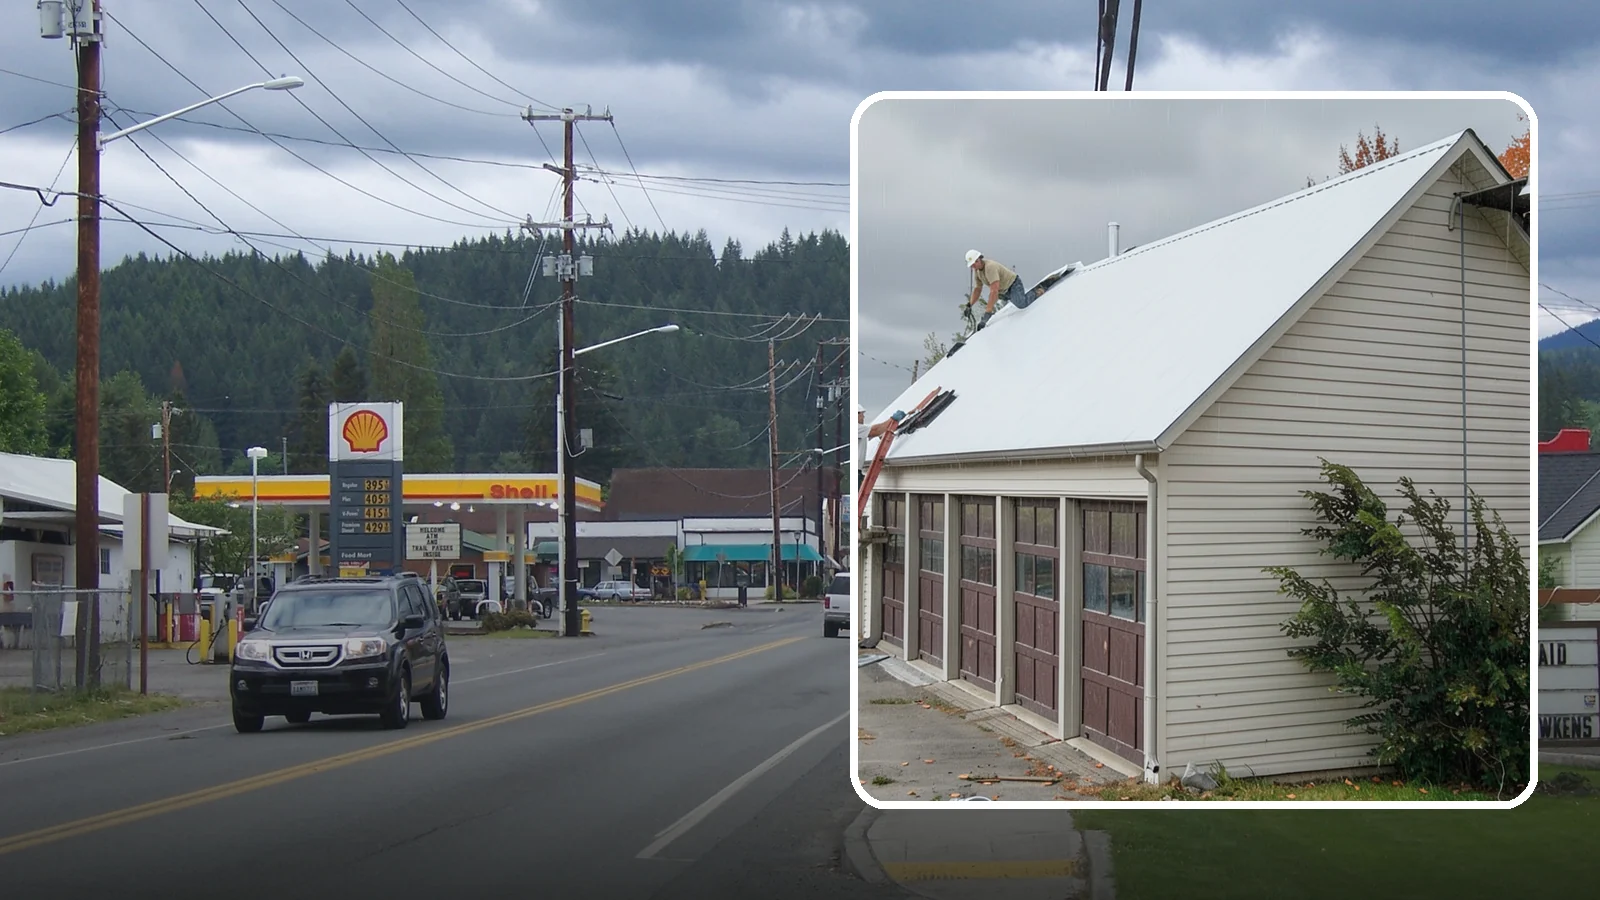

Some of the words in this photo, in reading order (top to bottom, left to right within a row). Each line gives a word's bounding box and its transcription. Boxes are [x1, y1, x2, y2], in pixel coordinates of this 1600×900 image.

[366, 480, 383, 490] 395
[490, 484, 548, 499] Shell
[366, 494, 383, 504] 405
[366, 508, 383, 518] 415
[366, 522, 383, 532] 429
